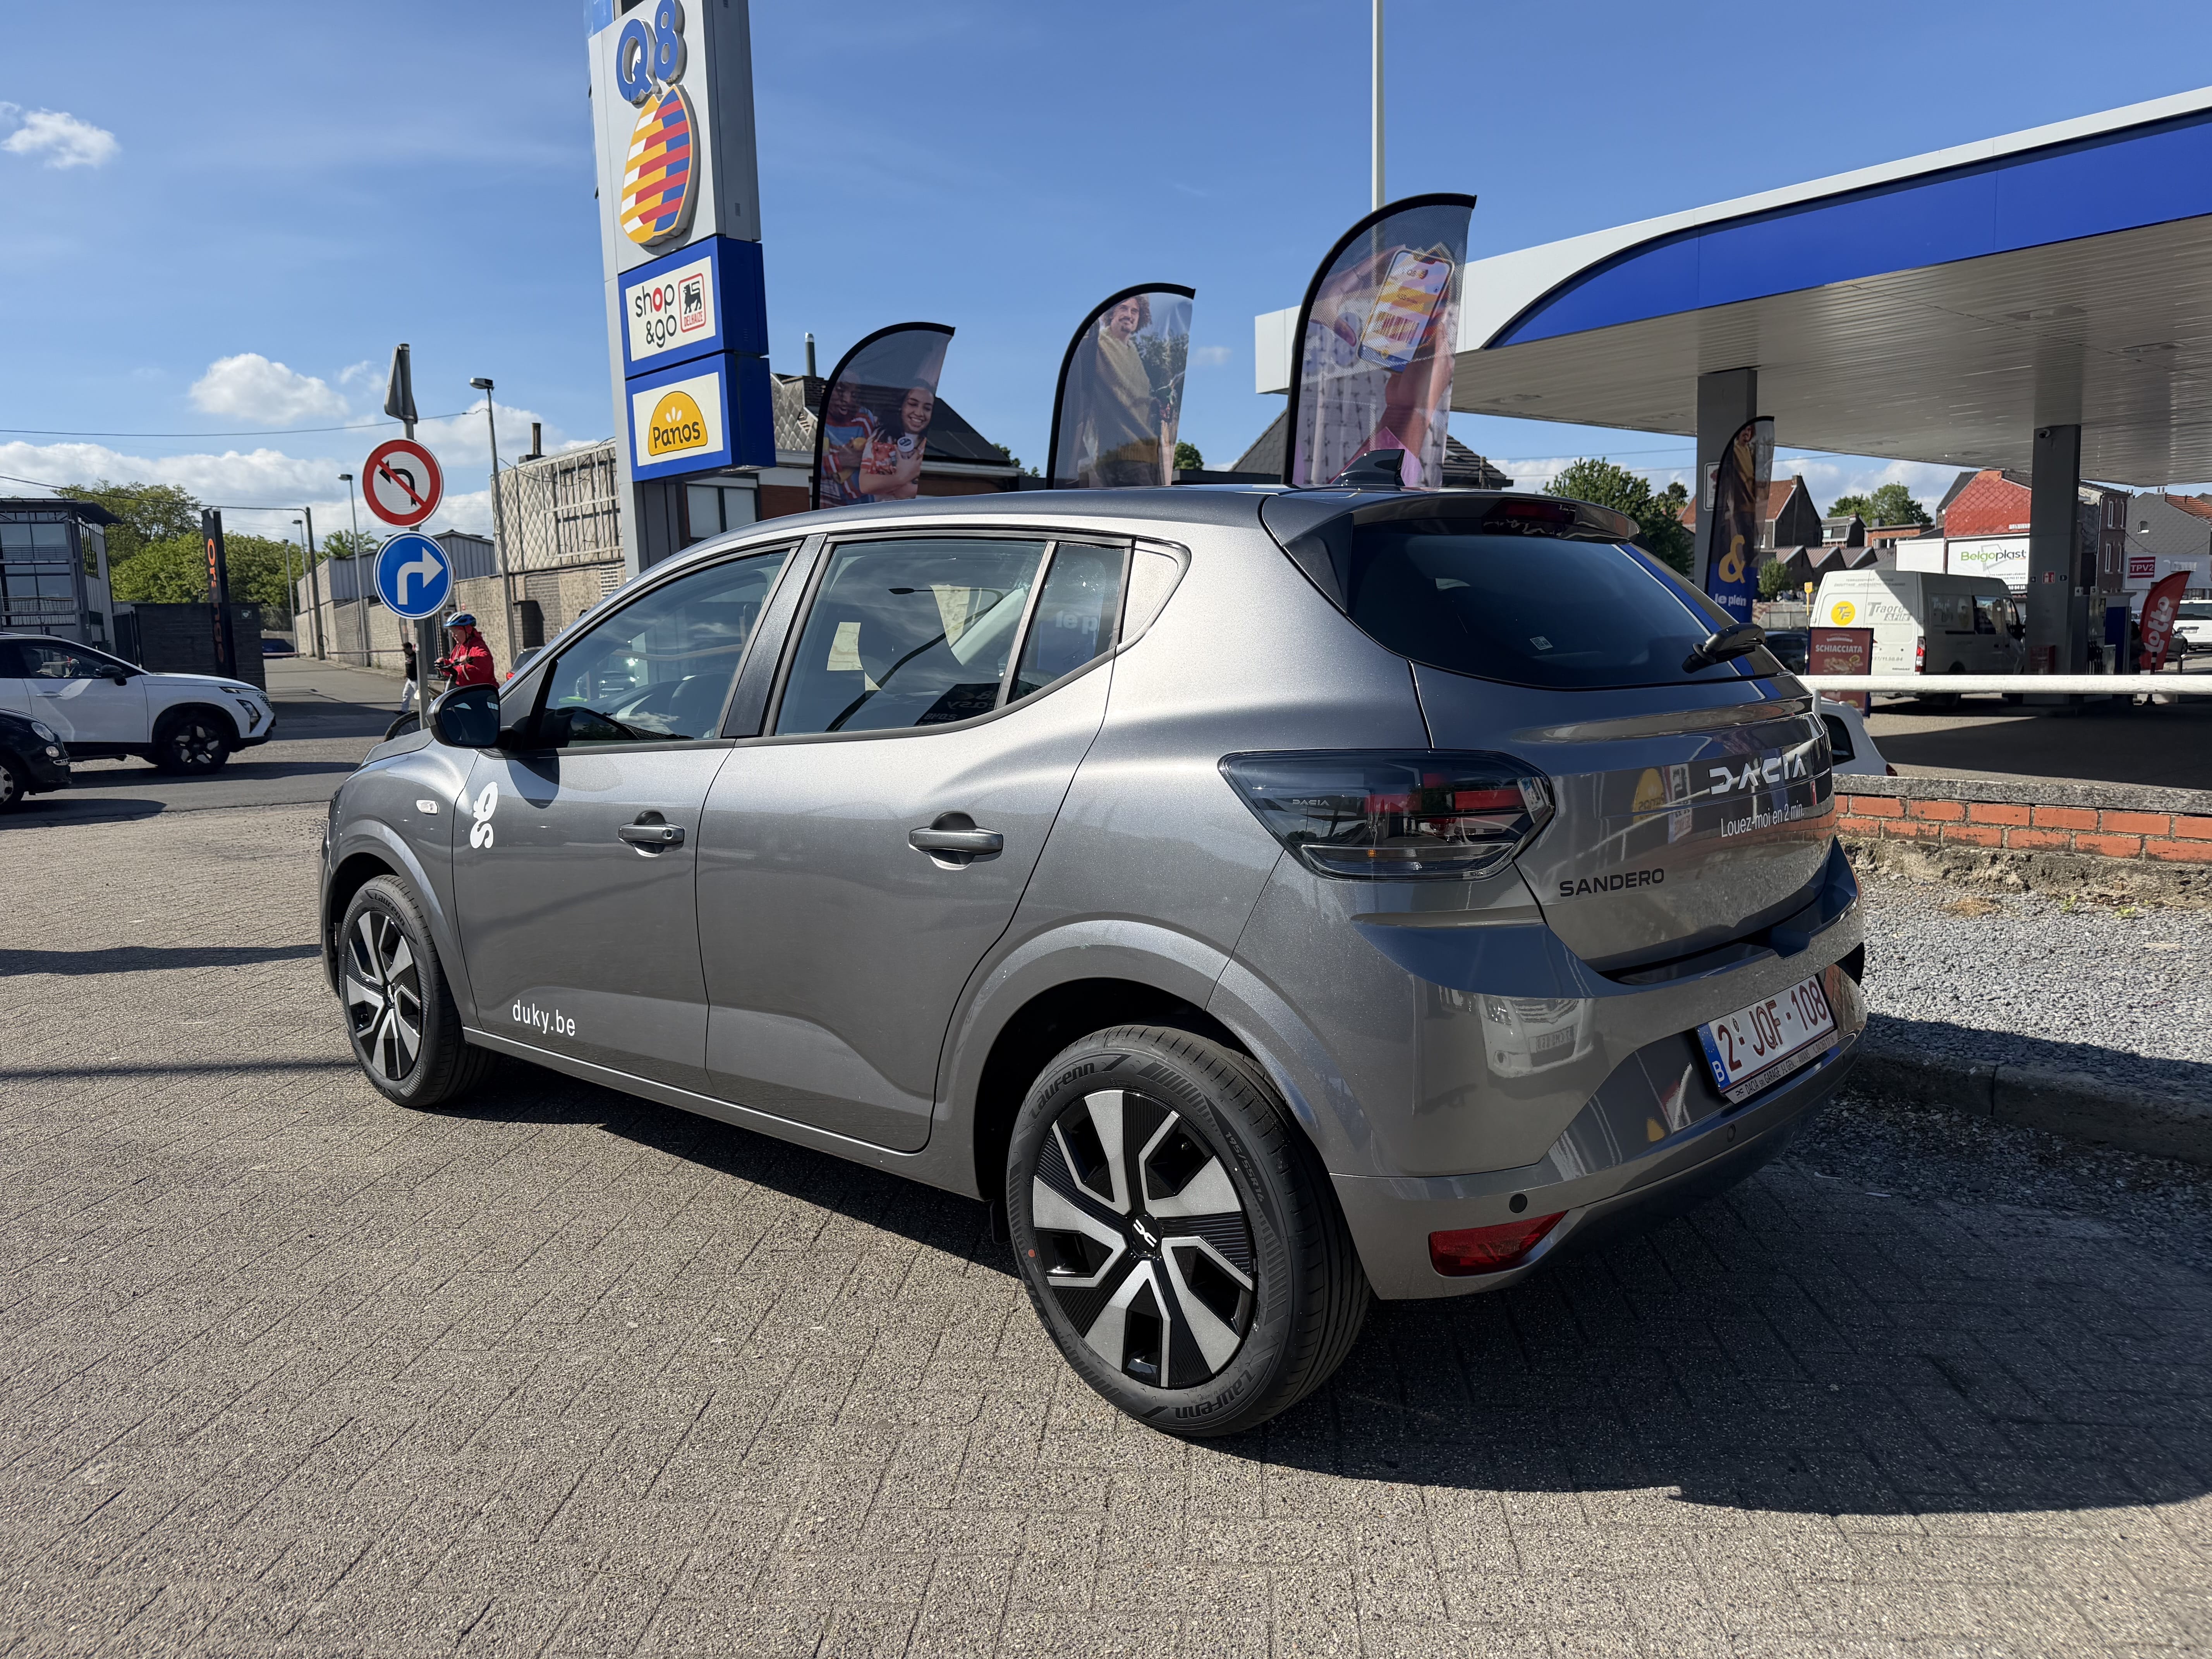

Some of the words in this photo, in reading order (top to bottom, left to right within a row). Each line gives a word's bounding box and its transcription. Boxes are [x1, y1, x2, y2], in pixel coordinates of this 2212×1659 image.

[616, 0, 684, 104] Q8
[635, 284, 675, 318] shop
[646, 314, 677, 348] &go
[684, 311, 703, 327] DELHAIZE
[653, 421, 701, 449] Panos
[1961, 549, 2026, 563] Belgoplast
[1714, 593, 1728, 604] le
[1728, 594, 1747, 607] plein
[1815, 644, 1863, 653] SCHIACCIATA
[1709, 754, 1807, 795] DACIA
[1721, 807, 1771, 838] Louez-moi
[1772, 809, 1783, 824] en
[1784, 803, 1789, 821] 2
[1791, 800, 1804, 819] min.
[1559, 868, 1664, 897] SANDERO
[513, 999, 575, 1036] duky.be
[1712, 1060, 1725, 1082] B
[1745, 1079, 1760, 1095] DACIA
[1764, 1066, 1781, 1084] GARAGE
[1029, 1063, 1095, 1119] Laufenn
[1225, 1131, 1264, 1202] 195/55R16
[1175, 1370, 1256, 1420] Laufenn
